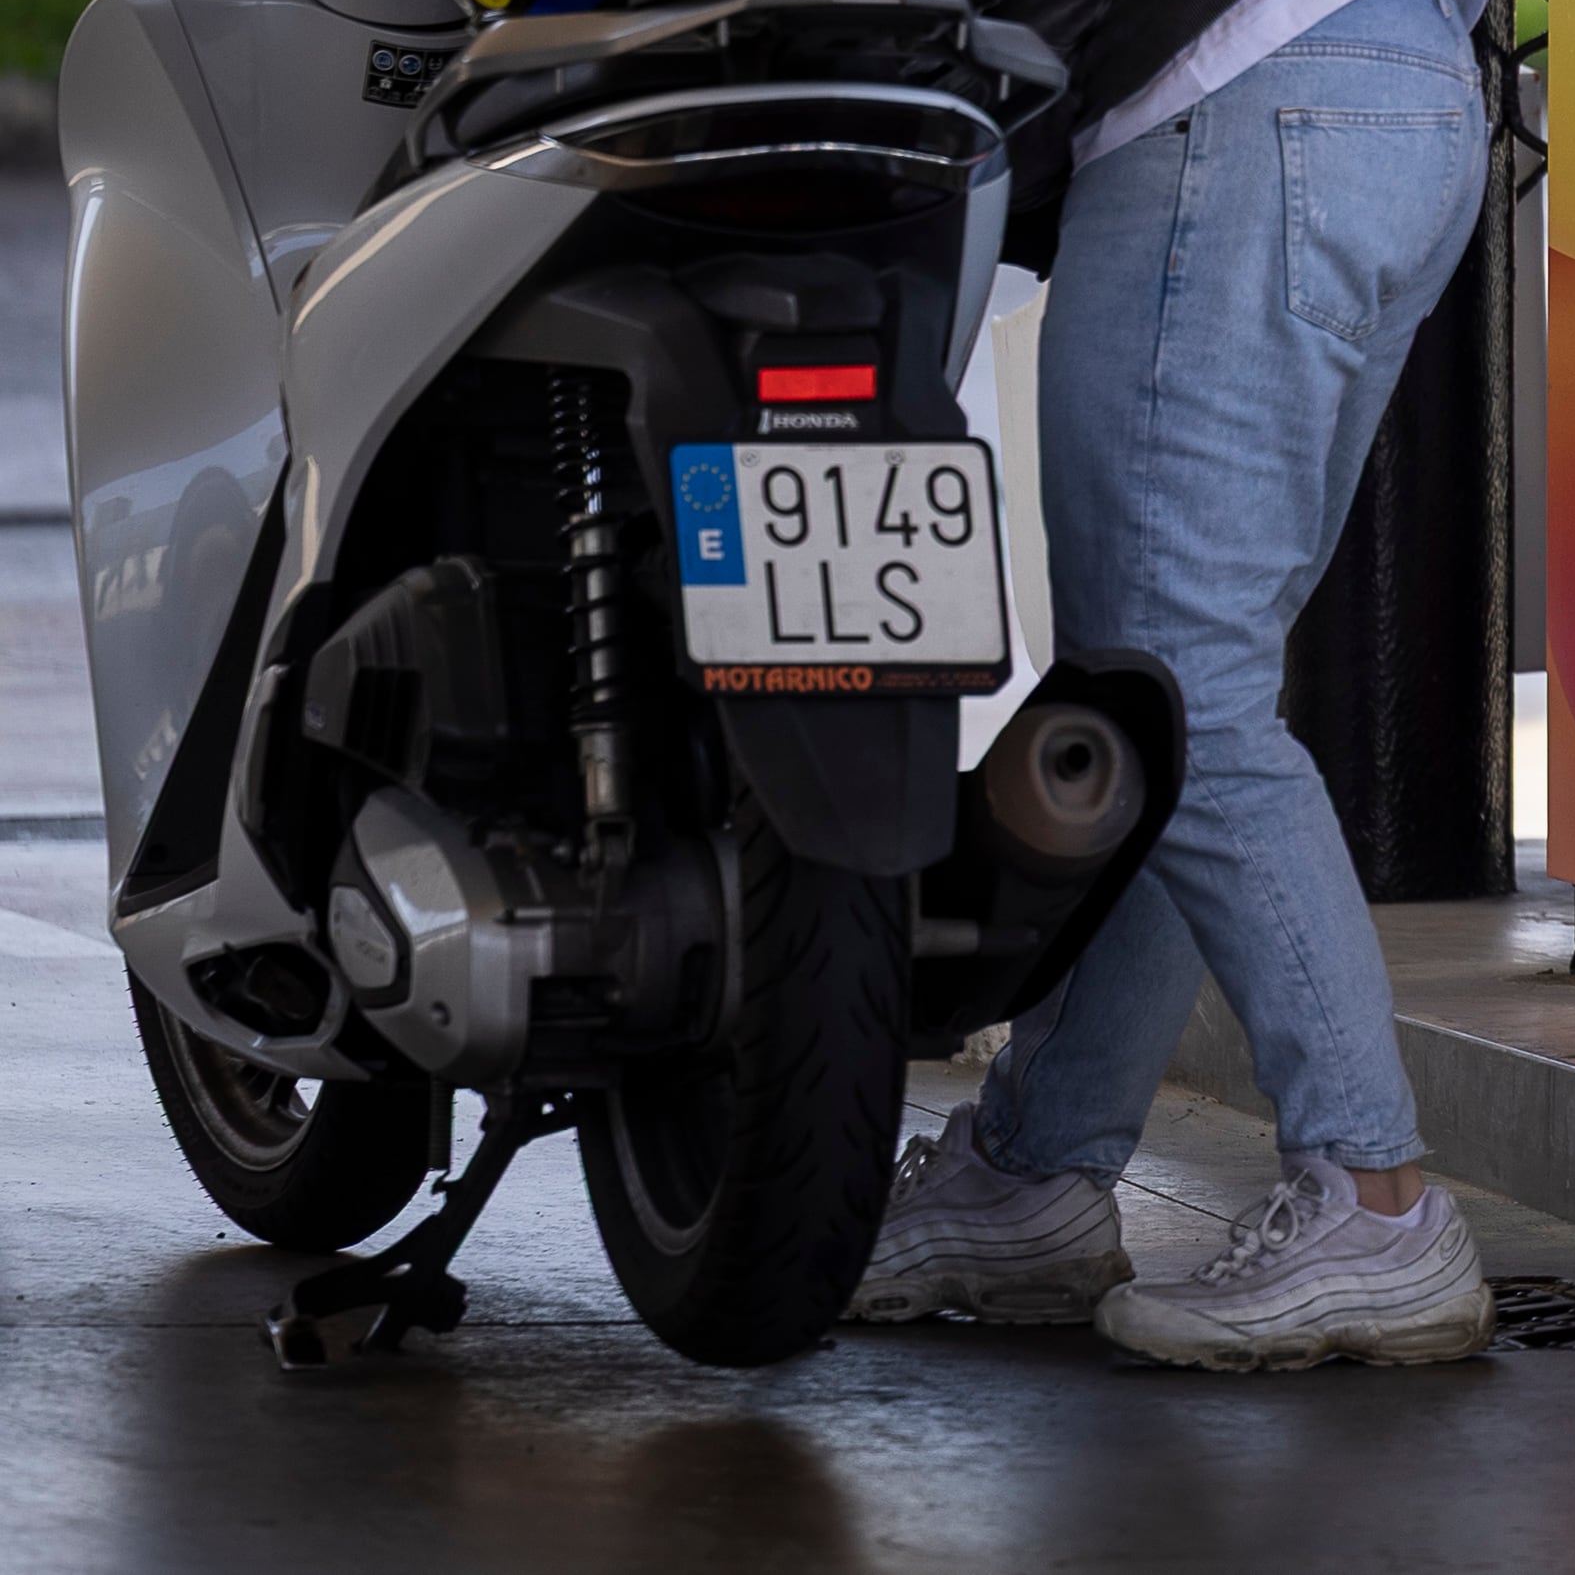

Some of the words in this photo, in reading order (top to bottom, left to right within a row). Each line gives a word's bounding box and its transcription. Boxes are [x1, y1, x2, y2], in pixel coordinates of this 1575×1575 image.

[699, 529, 725, 561] E
[761, 466, 973, 548] 9149
[764, 561, 923, 644] LLS
